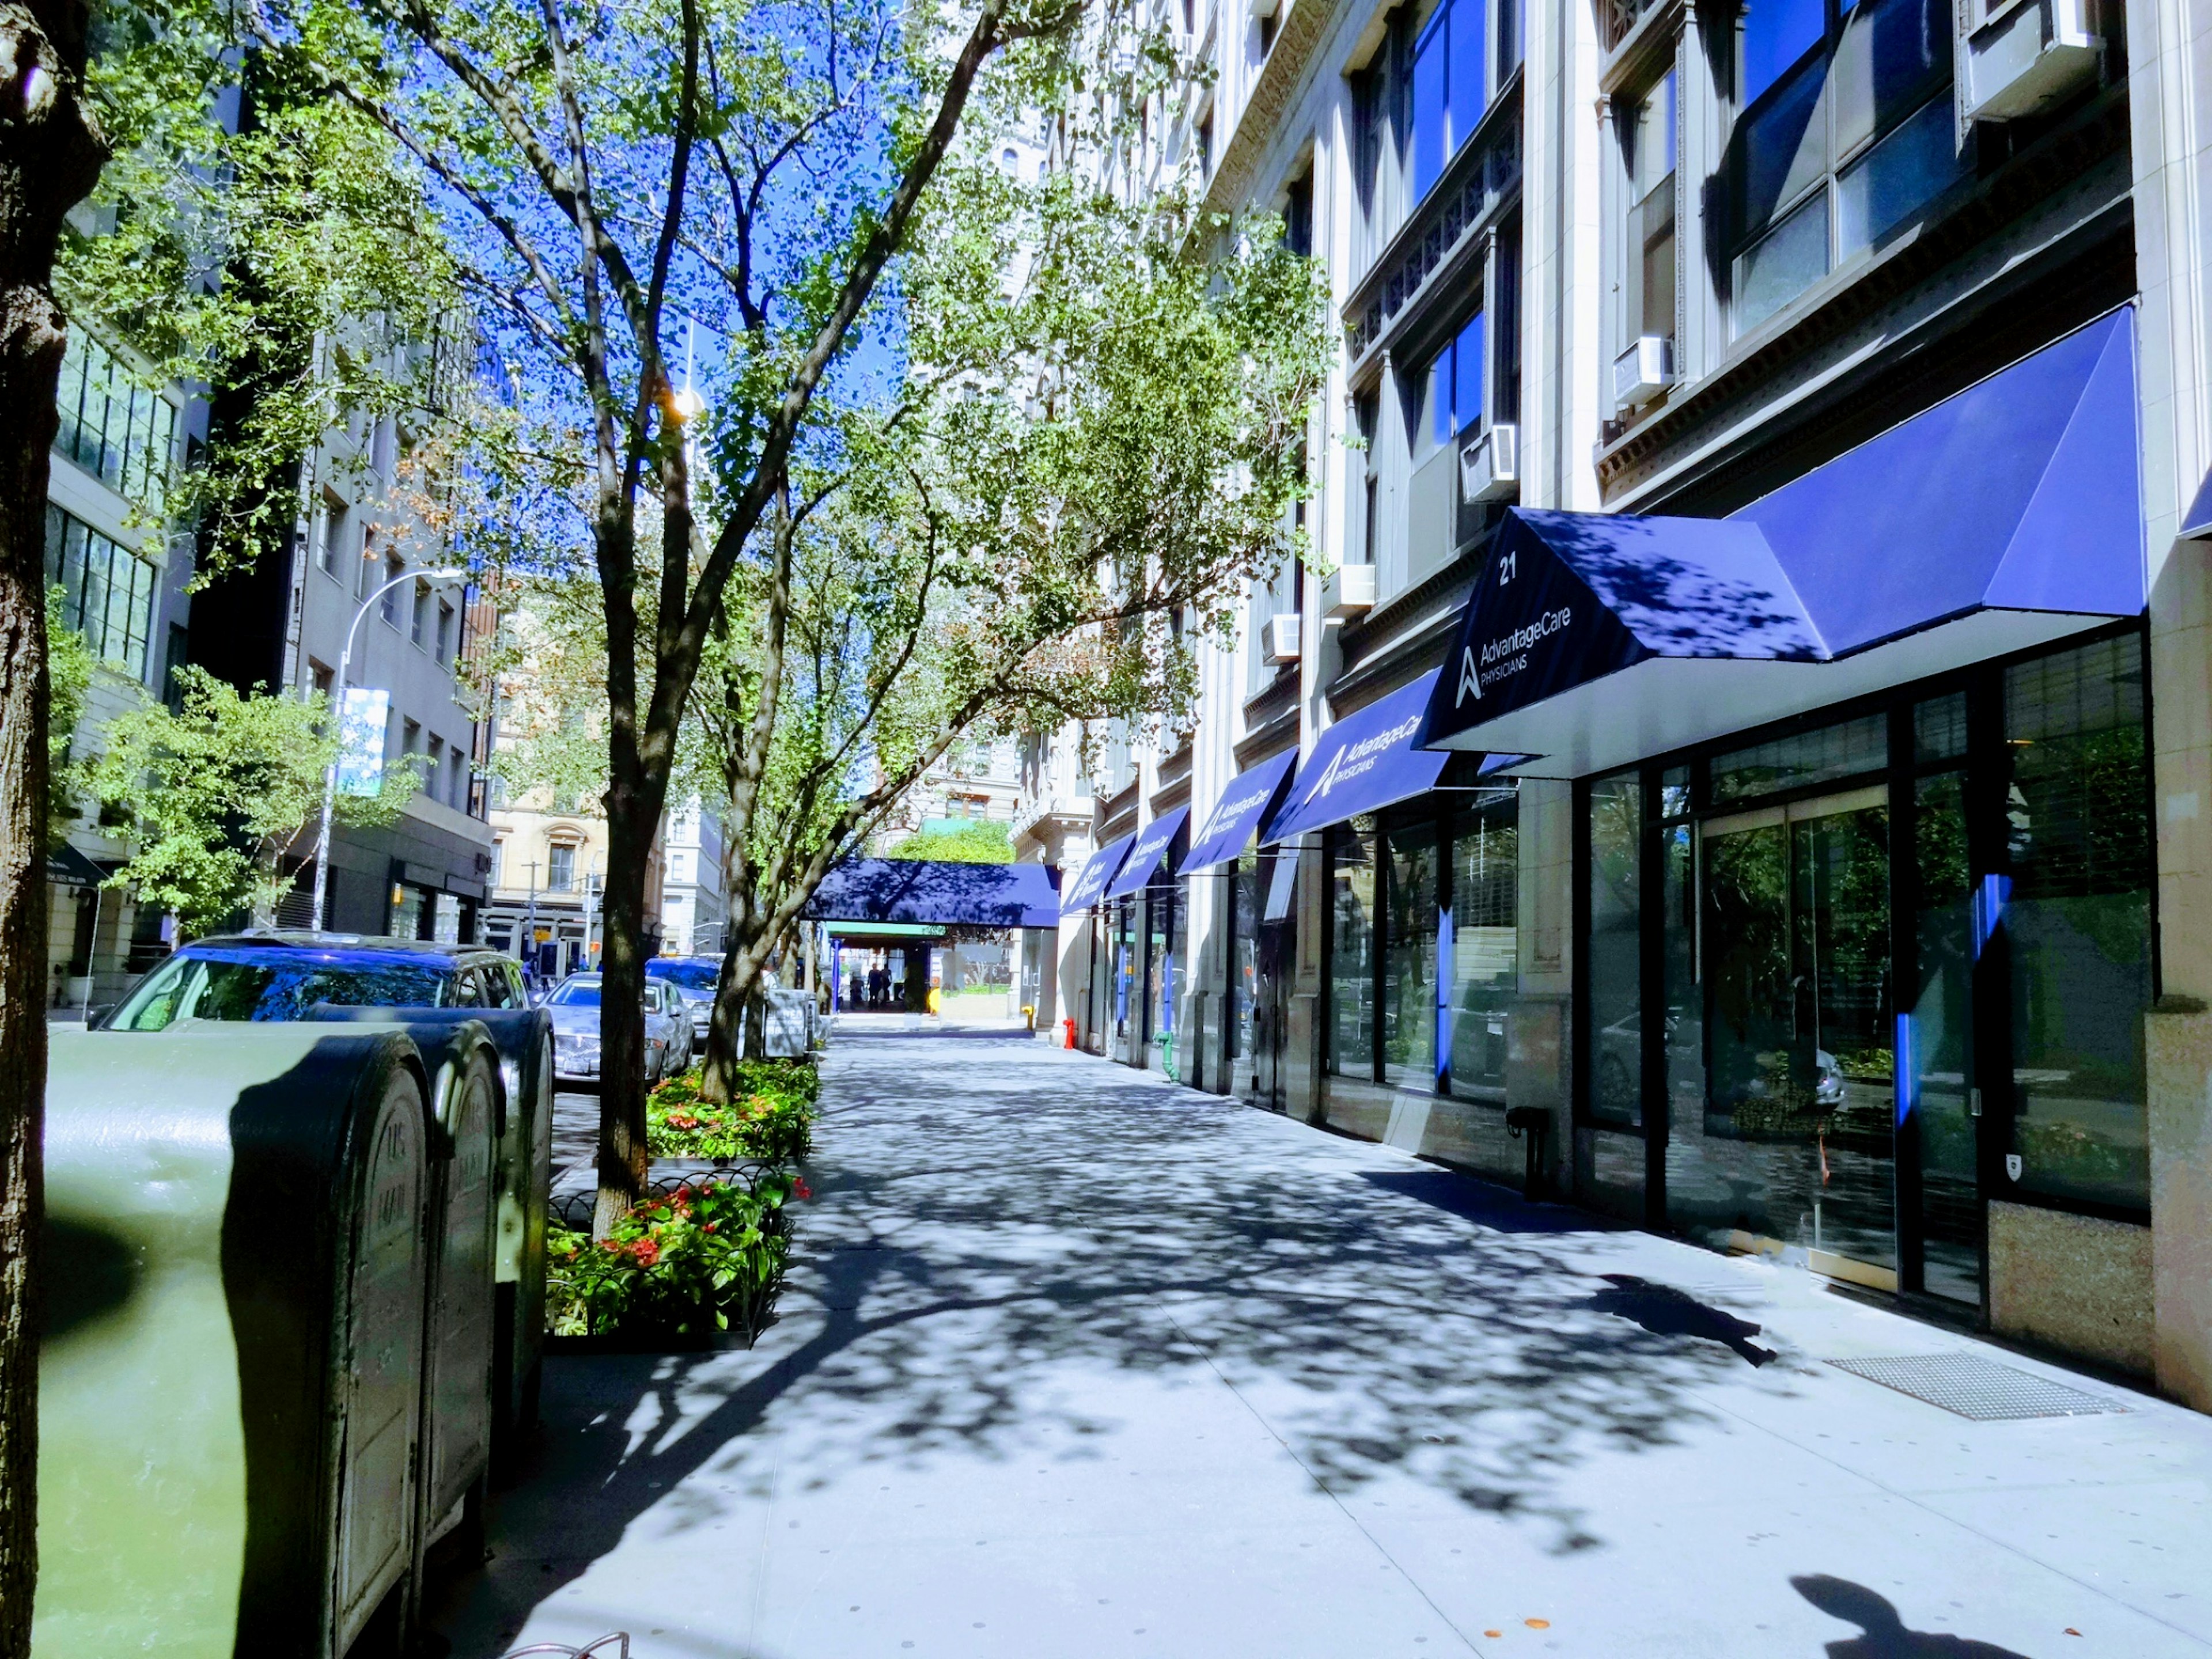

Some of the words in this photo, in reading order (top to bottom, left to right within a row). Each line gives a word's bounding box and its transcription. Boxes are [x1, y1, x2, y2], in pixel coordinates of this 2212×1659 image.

[1499, 551, 1516, 586] 21
[1480, 607, 1571, 666] AdvantageCare
[1481, 654, 1527, 687] PHYSICIANS
[1342, 715, 1423, 765] AdvantageCar
[1332, 756, 1377, 785] PHYSICIANS
